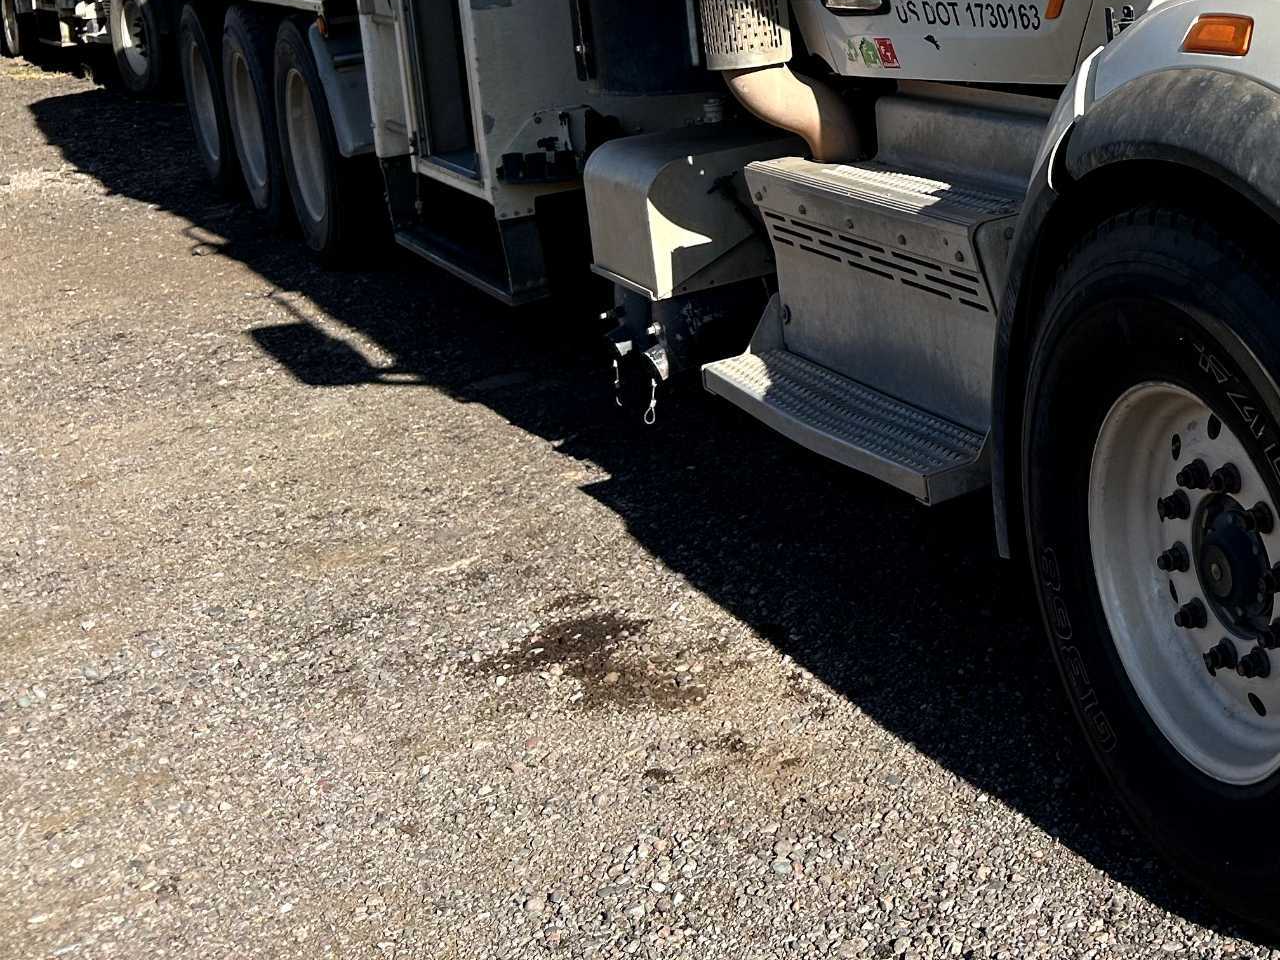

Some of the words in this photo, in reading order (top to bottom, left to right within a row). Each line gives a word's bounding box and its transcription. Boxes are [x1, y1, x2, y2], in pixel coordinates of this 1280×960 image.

[896, 0, 920, 24] US
[922, 1, 960, 26] DOT
[965, 3, 1041, 31] 1730163
